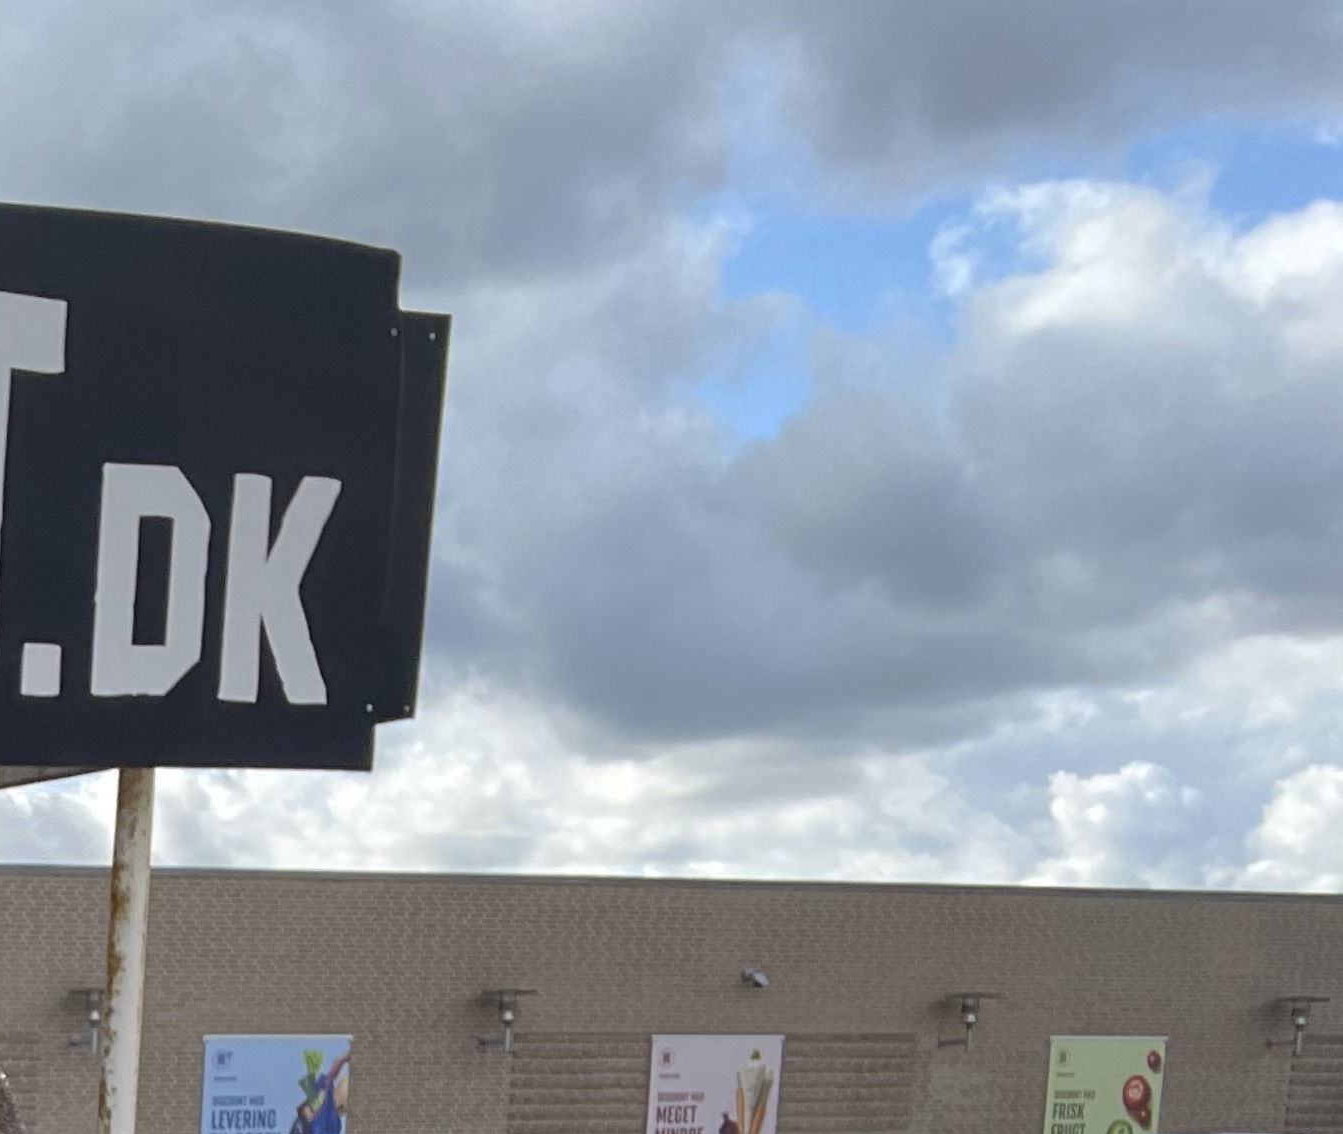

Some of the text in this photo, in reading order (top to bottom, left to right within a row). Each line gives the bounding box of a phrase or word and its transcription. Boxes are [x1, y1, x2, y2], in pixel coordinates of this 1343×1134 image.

[212, 1109, 276, 1130] LEVERING
[657, 1105, 697, 1123] MEGET
[1053, 1103, 1085, 1120] FRISK
